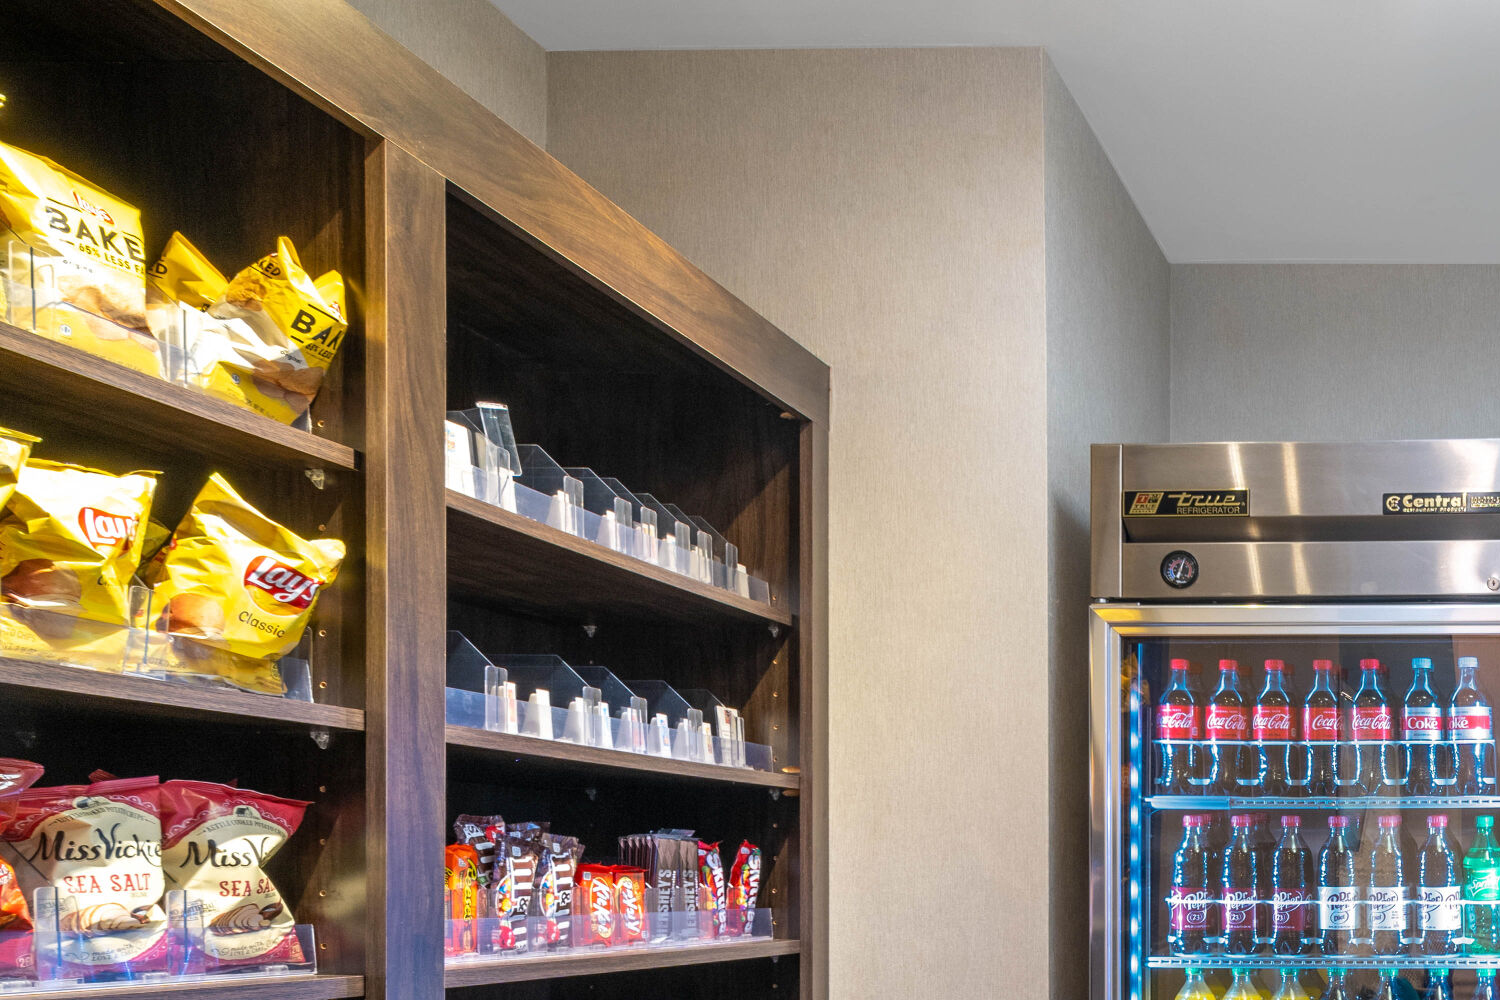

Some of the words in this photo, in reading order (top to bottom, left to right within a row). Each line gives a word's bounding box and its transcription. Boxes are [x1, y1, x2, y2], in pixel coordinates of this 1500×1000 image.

[104, 253, 131, 270] LESS
[1168, 492, 1242, 506] true
[1403, 491, 1468, 508] Central
[1176, 506, 1241, 515] REFRIGERATOR
[247, 556, 321, 603] Lay's
[238, 610, 286, 639] Classic
[1206, 712, 1248, 730] Coca-Cola
[1252, 712, 1293, 730] Coca-Cola
[1351, 713, 1392, 731] Coca-Cola
[1408, 716, 1439, 730] Coke
[1450, 716, 1469, 729] oke
[28, 830, 102, 862] Miss
[94, 822, 162, 868] Vickie
[179, 839, 252, 868] Miss
[63, 874, 102, 894] SEA
[109, 873, 151, 892] SALT
[219, 880, 252, 897] SEA
